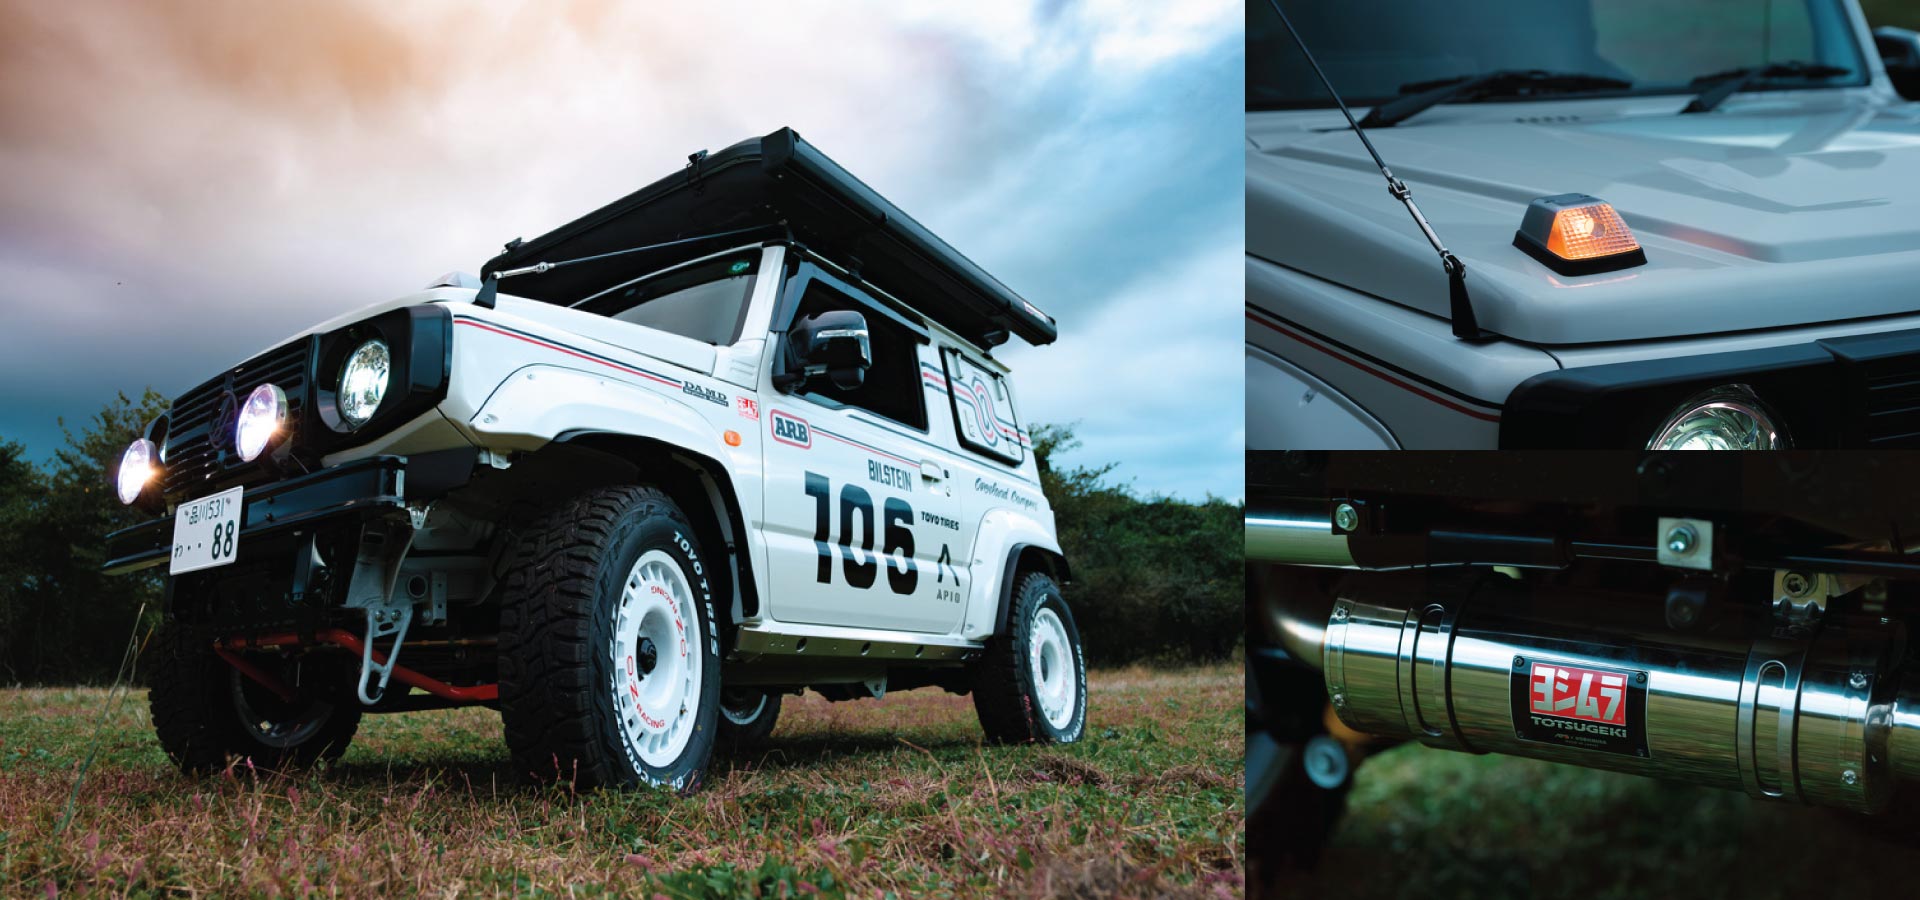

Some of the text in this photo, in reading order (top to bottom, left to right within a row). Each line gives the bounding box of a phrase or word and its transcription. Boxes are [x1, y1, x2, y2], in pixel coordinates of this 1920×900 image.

[684, 381, 727, 401] DAMD
[775, 417, 808, 443] ARB
[868, 459, 912, 492] BILSTEIN
[805, 470, 918, 595] 106
[921, 511, 960, 531] TOYO TIRES
[212, 520, 234, 560] 88
[673, 530, 719, 657] TOYO TIRES
[936, 589, 961, 604] APIO
[1533, 665, 1623, 721] ヨシムラ
[636, 703, 665, 729] RACING
[1530, 716, 1628, 738] TOTSUGEKI
